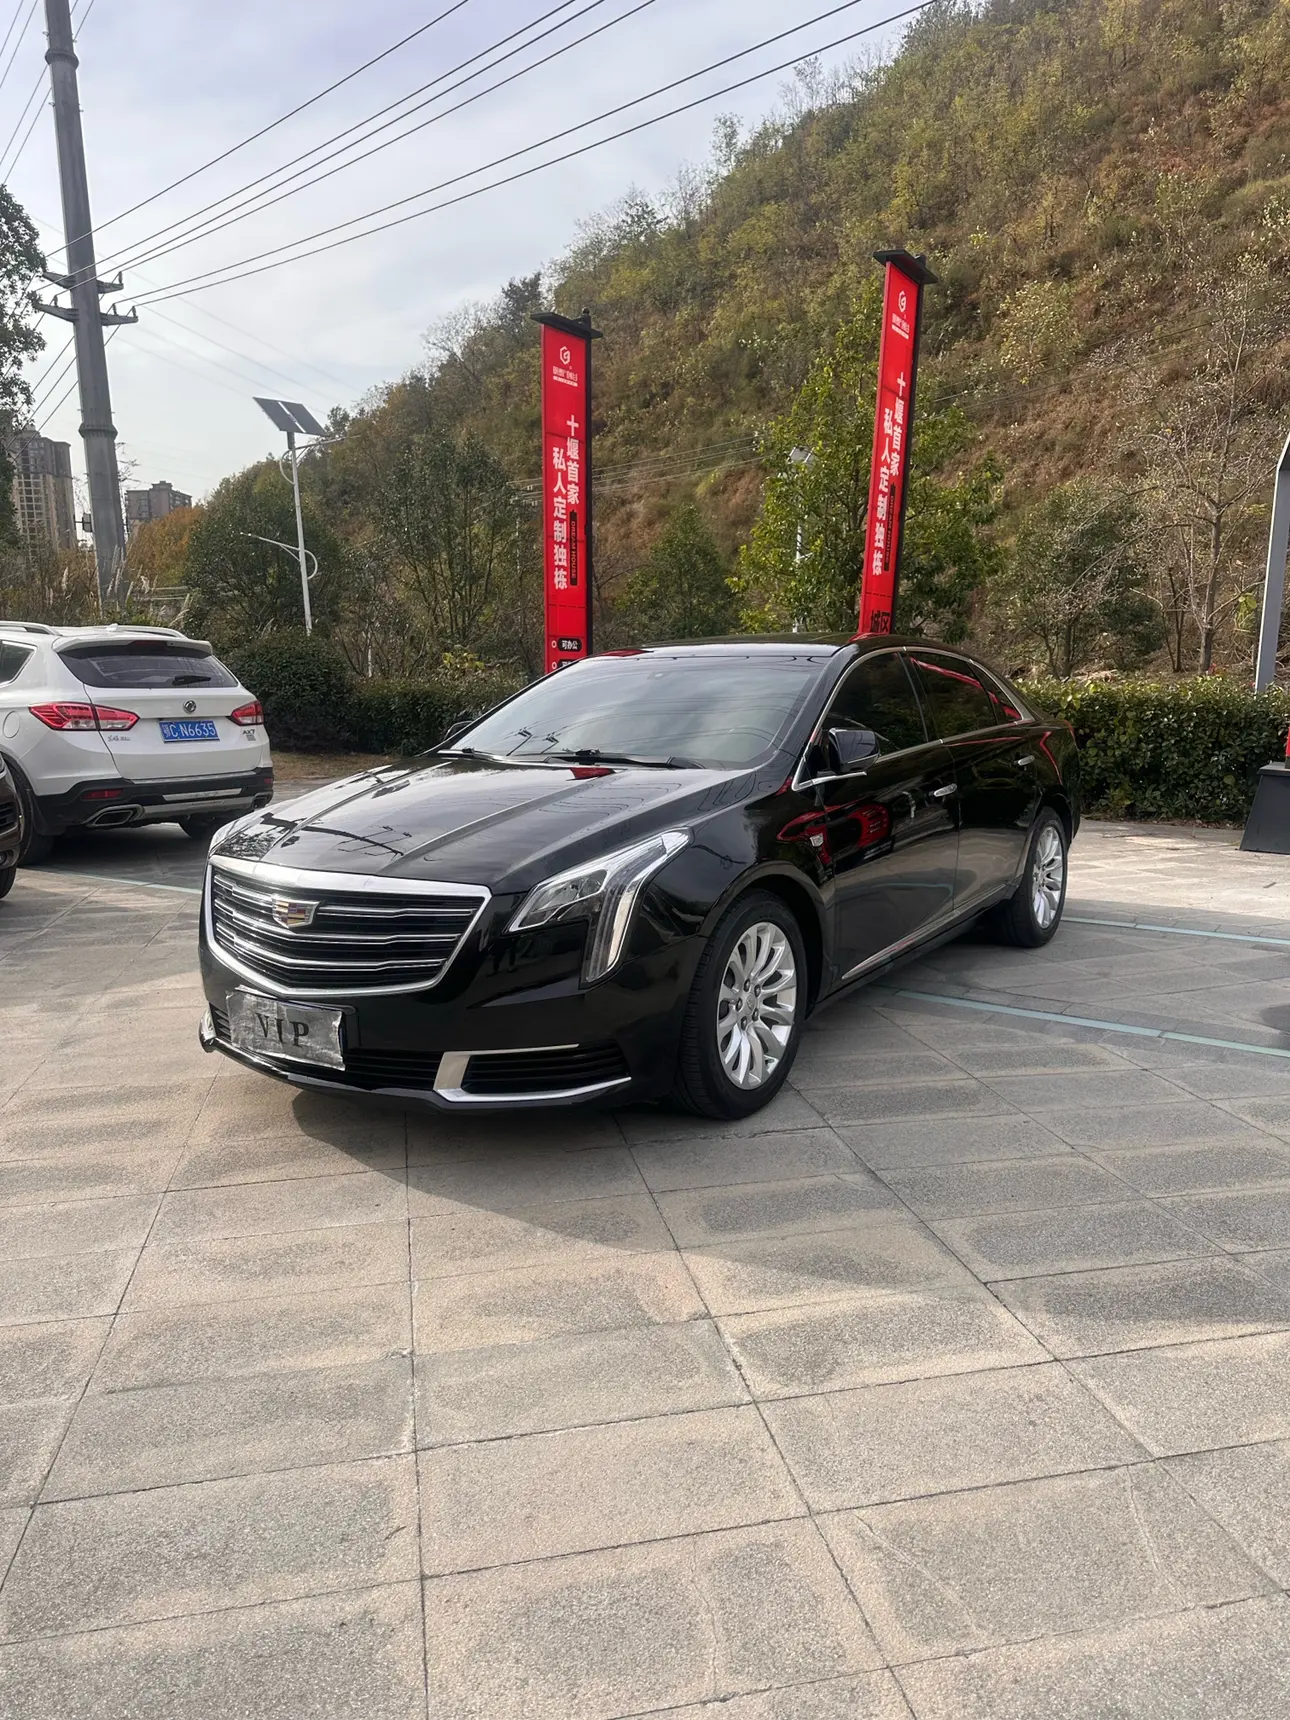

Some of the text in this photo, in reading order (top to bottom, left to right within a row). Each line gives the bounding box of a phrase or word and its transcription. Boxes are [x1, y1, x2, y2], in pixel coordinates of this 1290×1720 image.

[566, 414, 580, 505] 十堰首家
[890, 372, 906, 476] 十堰首家
[553, 447, 568, 590] 私人定制独栋
[872, 408, 893, 576] 私人定制独栋
[561, 640, 578, 650] 可办公
[255, 1012, 309, 1048] VIP
